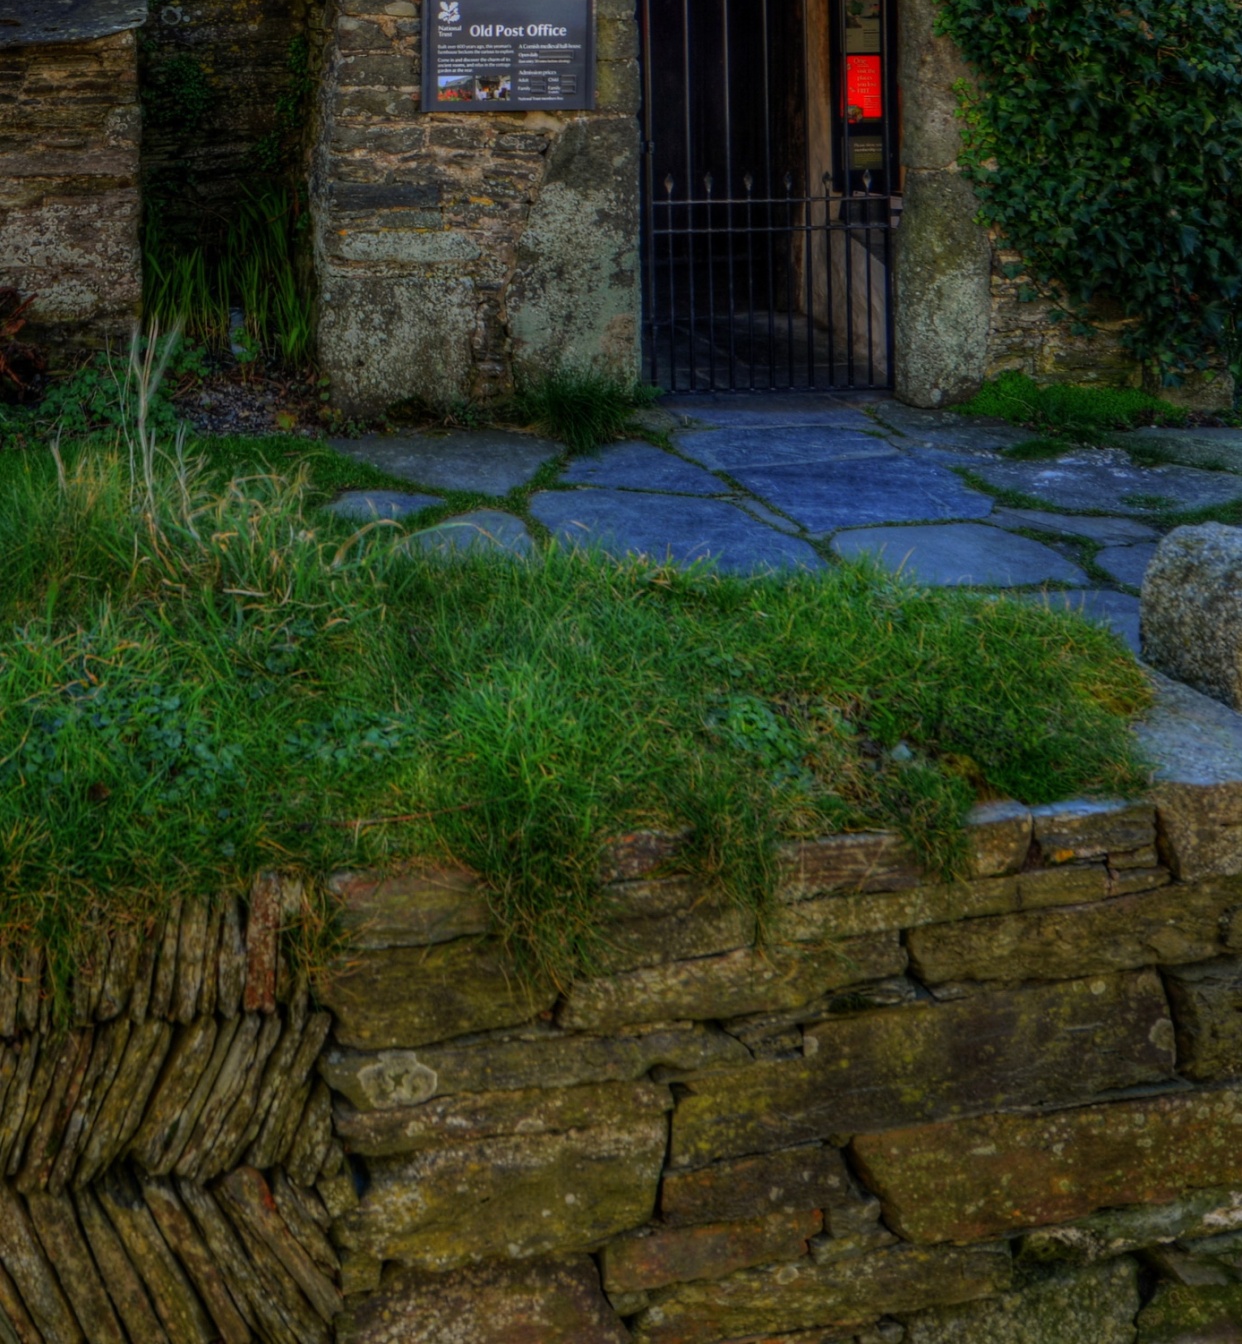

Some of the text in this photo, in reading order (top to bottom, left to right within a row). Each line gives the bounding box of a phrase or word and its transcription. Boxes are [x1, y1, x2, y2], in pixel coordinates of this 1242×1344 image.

[470, 24, 567, 37] Old Post Office
